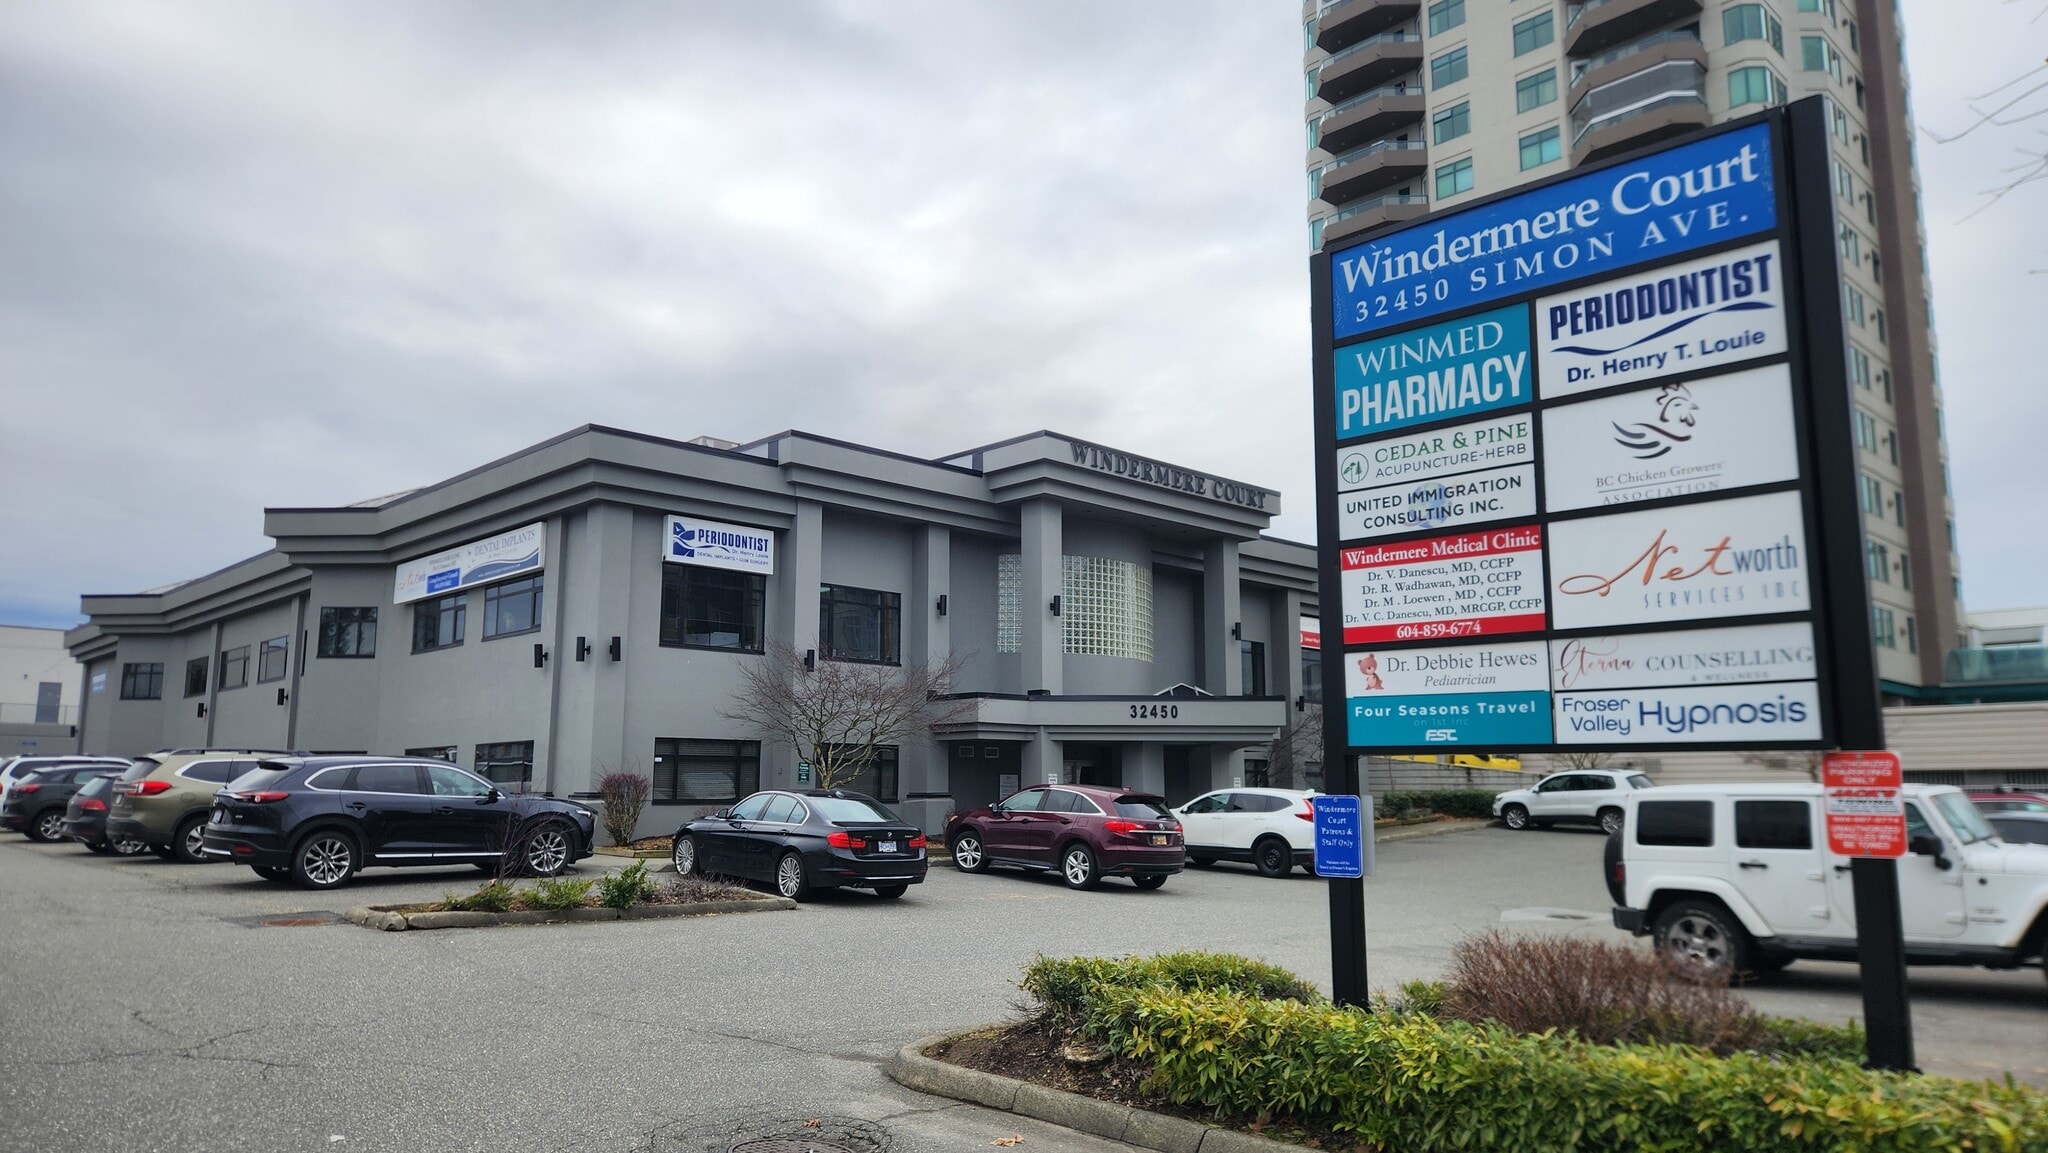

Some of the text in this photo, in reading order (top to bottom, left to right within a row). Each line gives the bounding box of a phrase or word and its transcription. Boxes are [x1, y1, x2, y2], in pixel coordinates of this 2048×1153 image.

[1340, 144, 1759, 294] Windermere Court
[1355, 201, 1749, 323] 32450 SIMON AVE.
[1550, 254, 1772, 341] PERIODONTIST
[1355, 321, 1504, 377] WINMED
[1567, 329, 1766, 383] Dr. Henry T. Louie
[1342, 351, 1527, 430] PHARMACY
[1375, 422, 1528, 463] CEDAR & PINE
[1375, 443, 1527, 478] ACUPUNCTURE-HERB
[1069, 441, 1266, 509] WINDERMERE COURT
[1596, 476, 1614, 488] BC
[1618, 470, 1666, 485] Chicken
[1346, 475, 1522, 514] UNITED IMMIGRATION
[1603, 480, 1719, 506] ASSOCIATION
[1363, 498, 1504, 529] CONSULTING INC.
[698, 528, 769, 552] PERIODONTIST
[1346, 531, 1540, 566] Windermere Medical Clinic
[1367, 557, 1515, 582] Dr. V. Danescu, MD, CCFP
[1362, 571, 1522, 595] Dr. R. Wadhawan, MD, CCFP
[1364, 598, 1380, 608] Dr.
[1487, 585, 1522, 598] CCFP
[1643, 585, 1745, 609] SERVICES
[1345, 598, 1542, 623] Dr. V. C. Danescu, MD, MRCGP, CCFP
[1396, 620, 1482, 639] 604-859-6774
[1387, 651, 1538, 672] Dr. Debbie Hewes
[1646, 648, 1813, 672] COUNSELLING
[1424, 674, 1497, 687] Pediatrician
[1130, 704, 1178, 719] 32450
[1355, 700, 1536, 718] Four Seasons Travel
[1562, 695, 1808, 734] Fraser Hypnosis
[1413, 718, 1428, 727] on
[1570, 715, 1631, 735] Valley
[1317, 805, 1357, 813] Windermere
[1327, 816, 1347, 824] Court
[1321, 827, 1346, 835] Patrons
[1322, 838, 1353, 848] Staff Only
